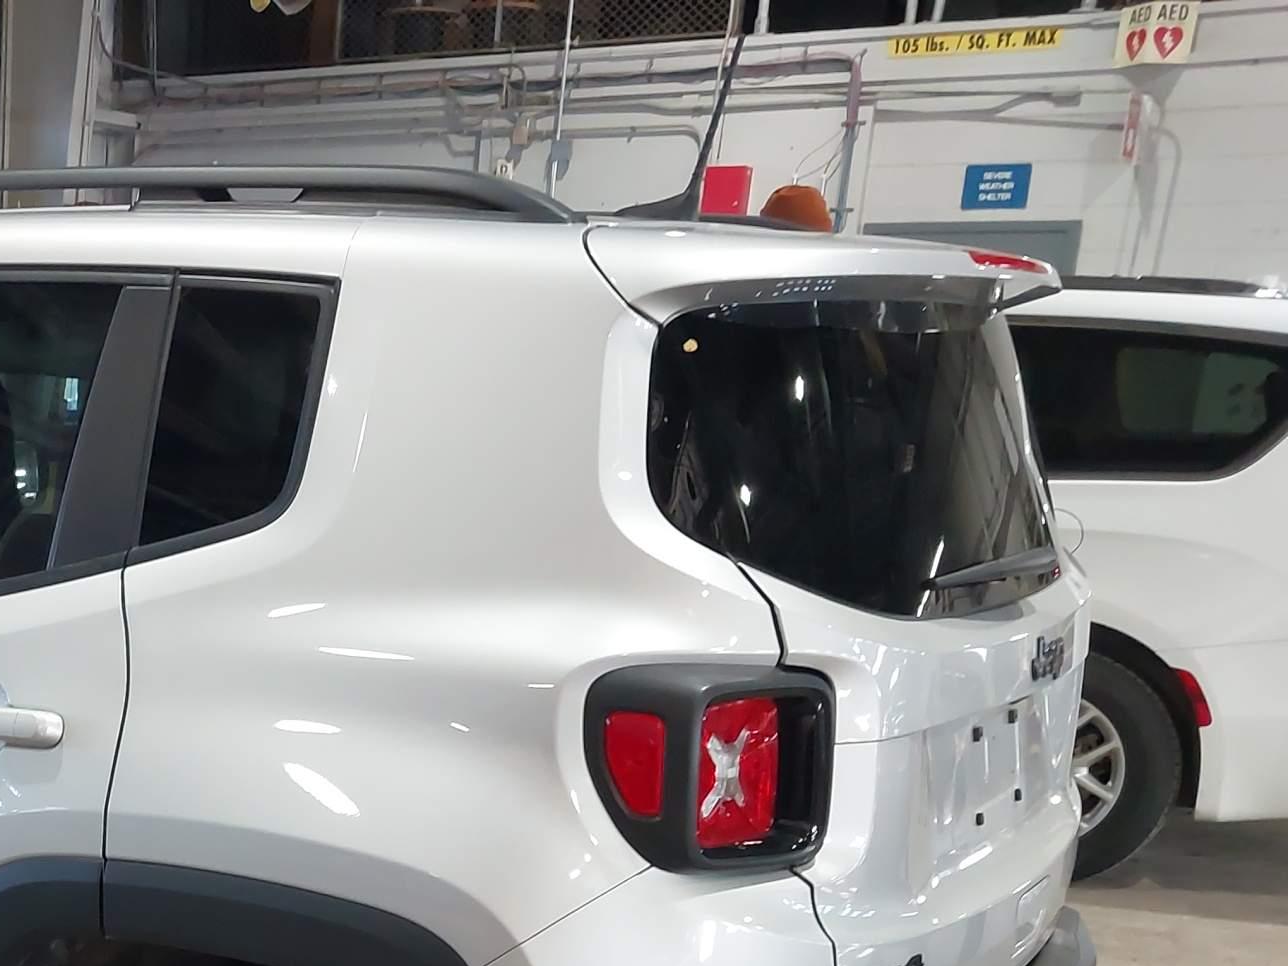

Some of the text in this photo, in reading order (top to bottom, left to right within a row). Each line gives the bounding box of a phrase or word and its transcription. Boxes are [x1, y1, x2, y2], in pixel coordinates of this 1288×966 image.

[1129, 4, 1189, 24] AED AED
[894, 37, 920, 54] 105
[925, 36, 950, 52] lbs.
[967, 33, 990, 50] SQ.
[996, 32, 1016, 48] FT.
[1023, 28, 1058, 46] MAX
